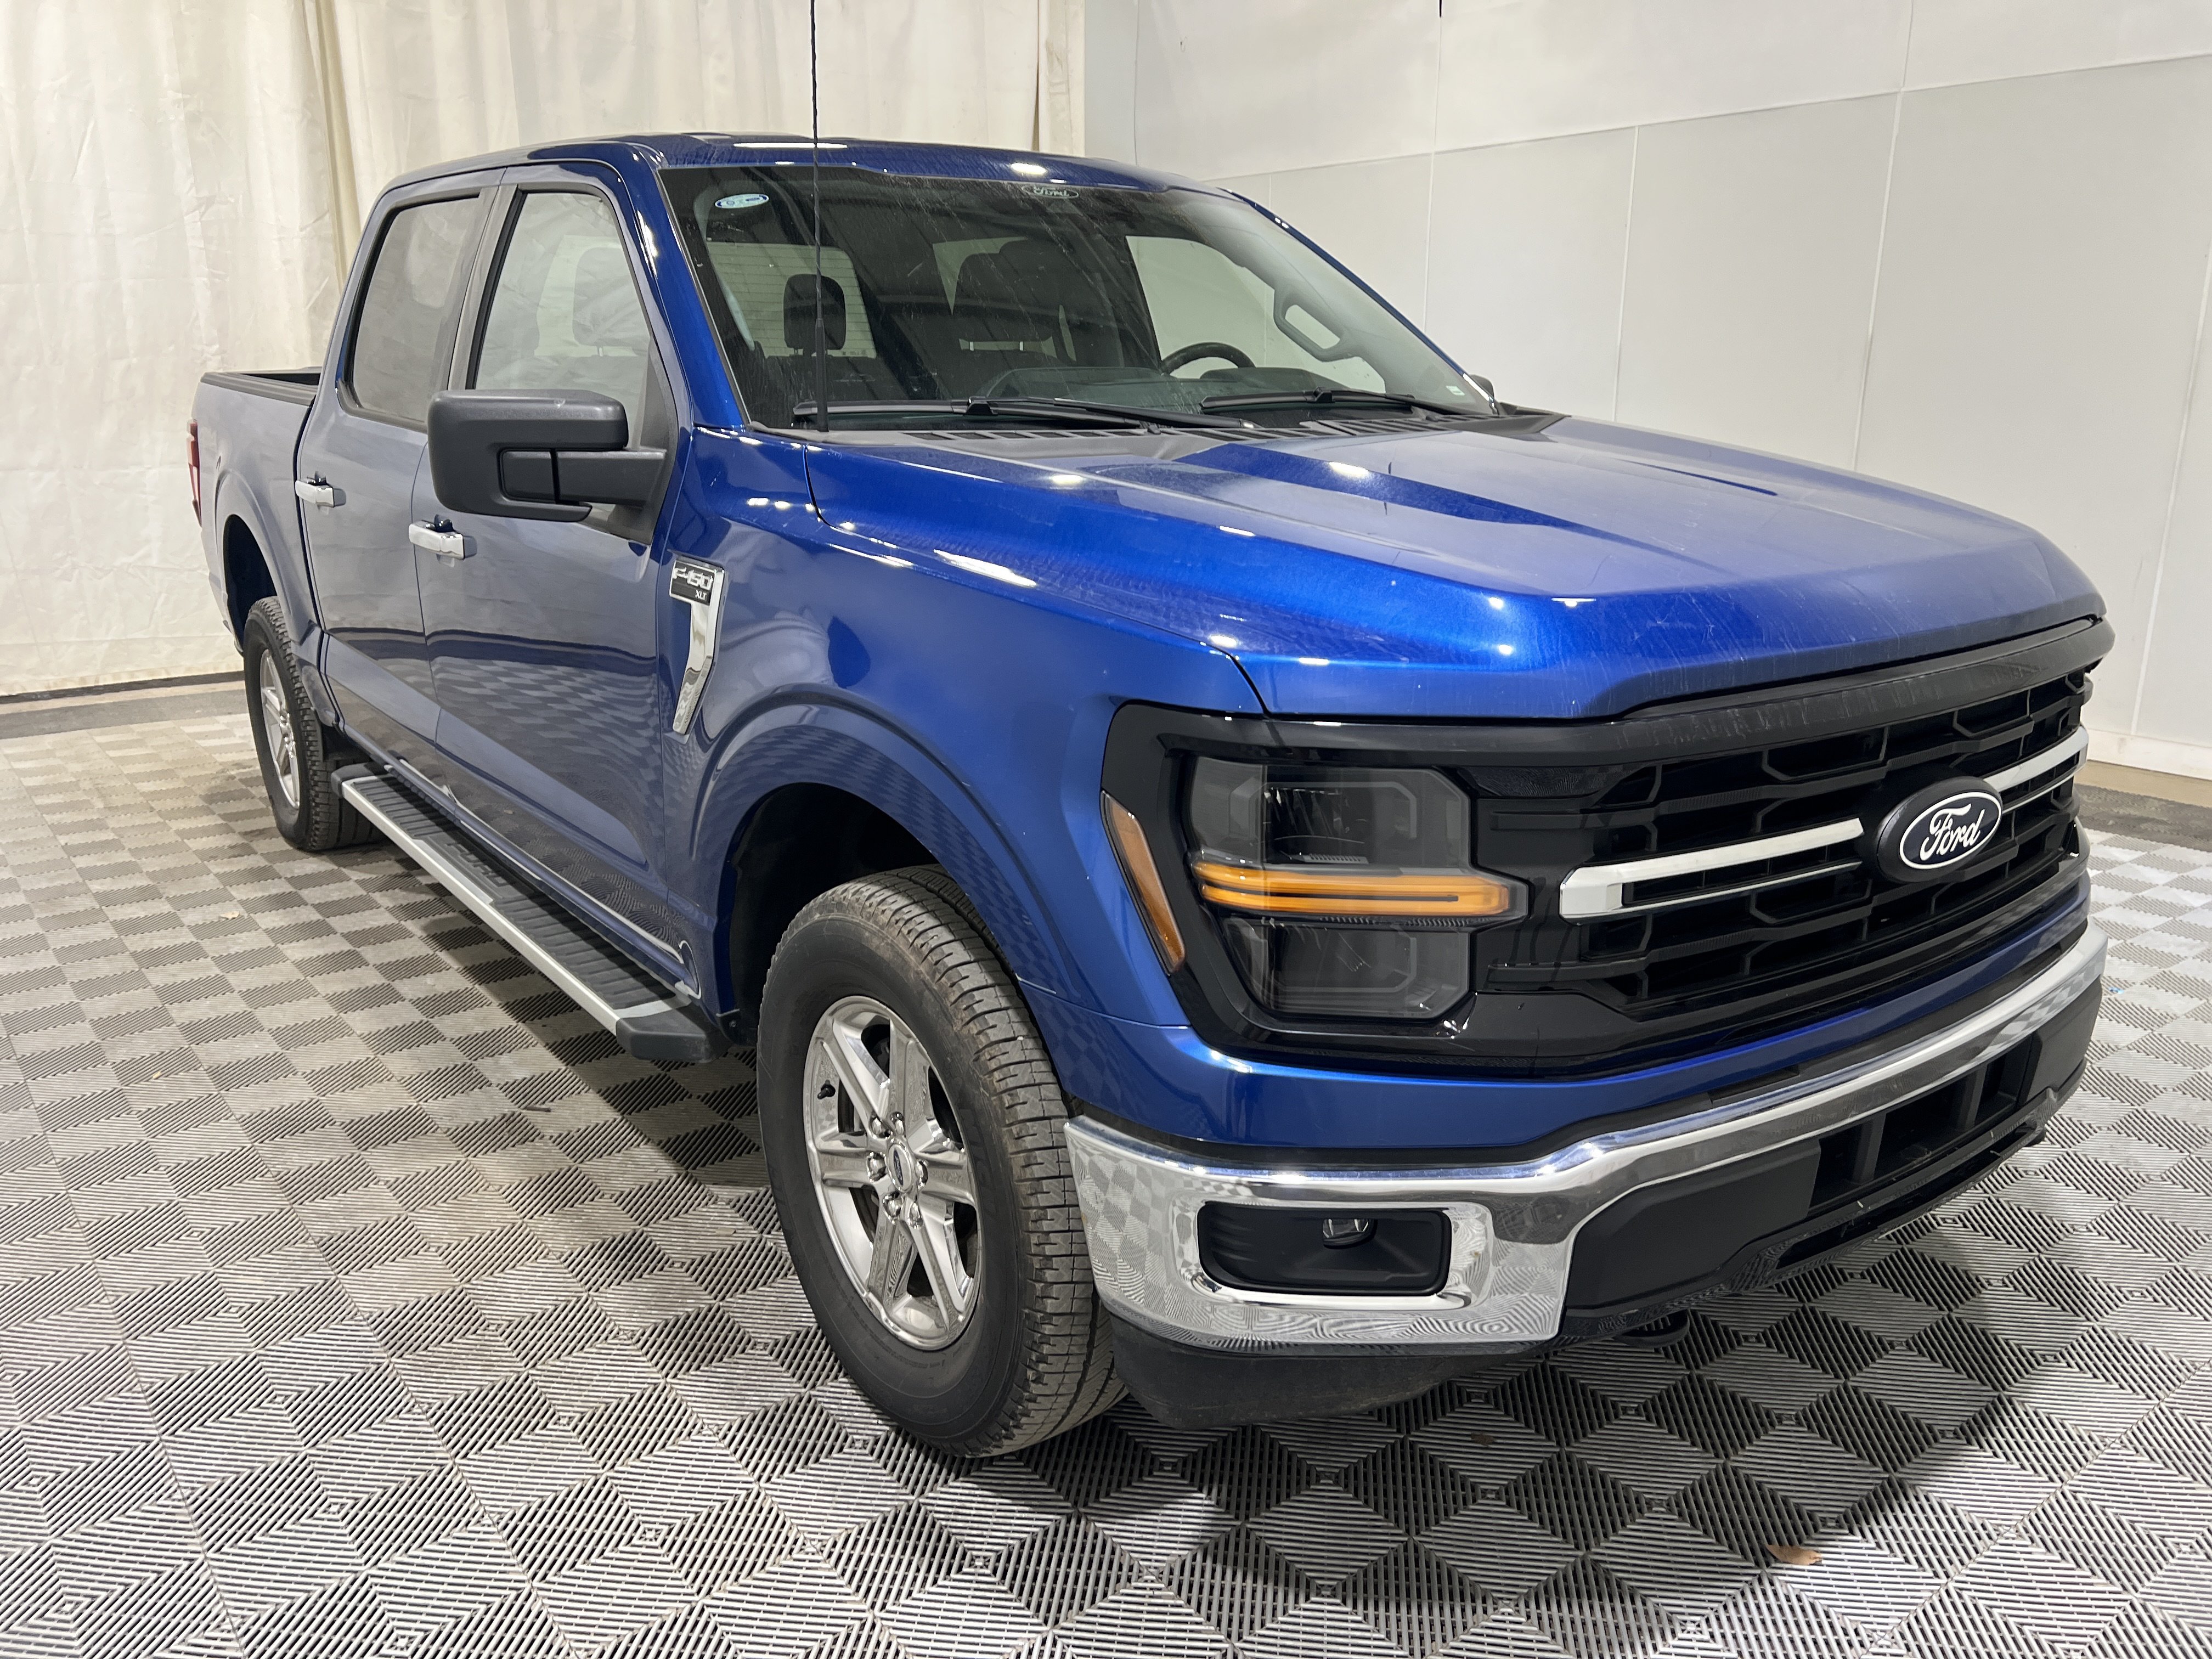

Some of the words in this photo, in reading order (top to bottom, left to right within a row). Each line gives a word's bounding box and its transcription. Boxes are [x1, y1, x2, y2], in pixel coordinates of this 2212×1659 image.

[673, 567, 713, 591] F-150
[695, 589, 707, 601] XLT
[1920, 803, 1985, 861] Ford
